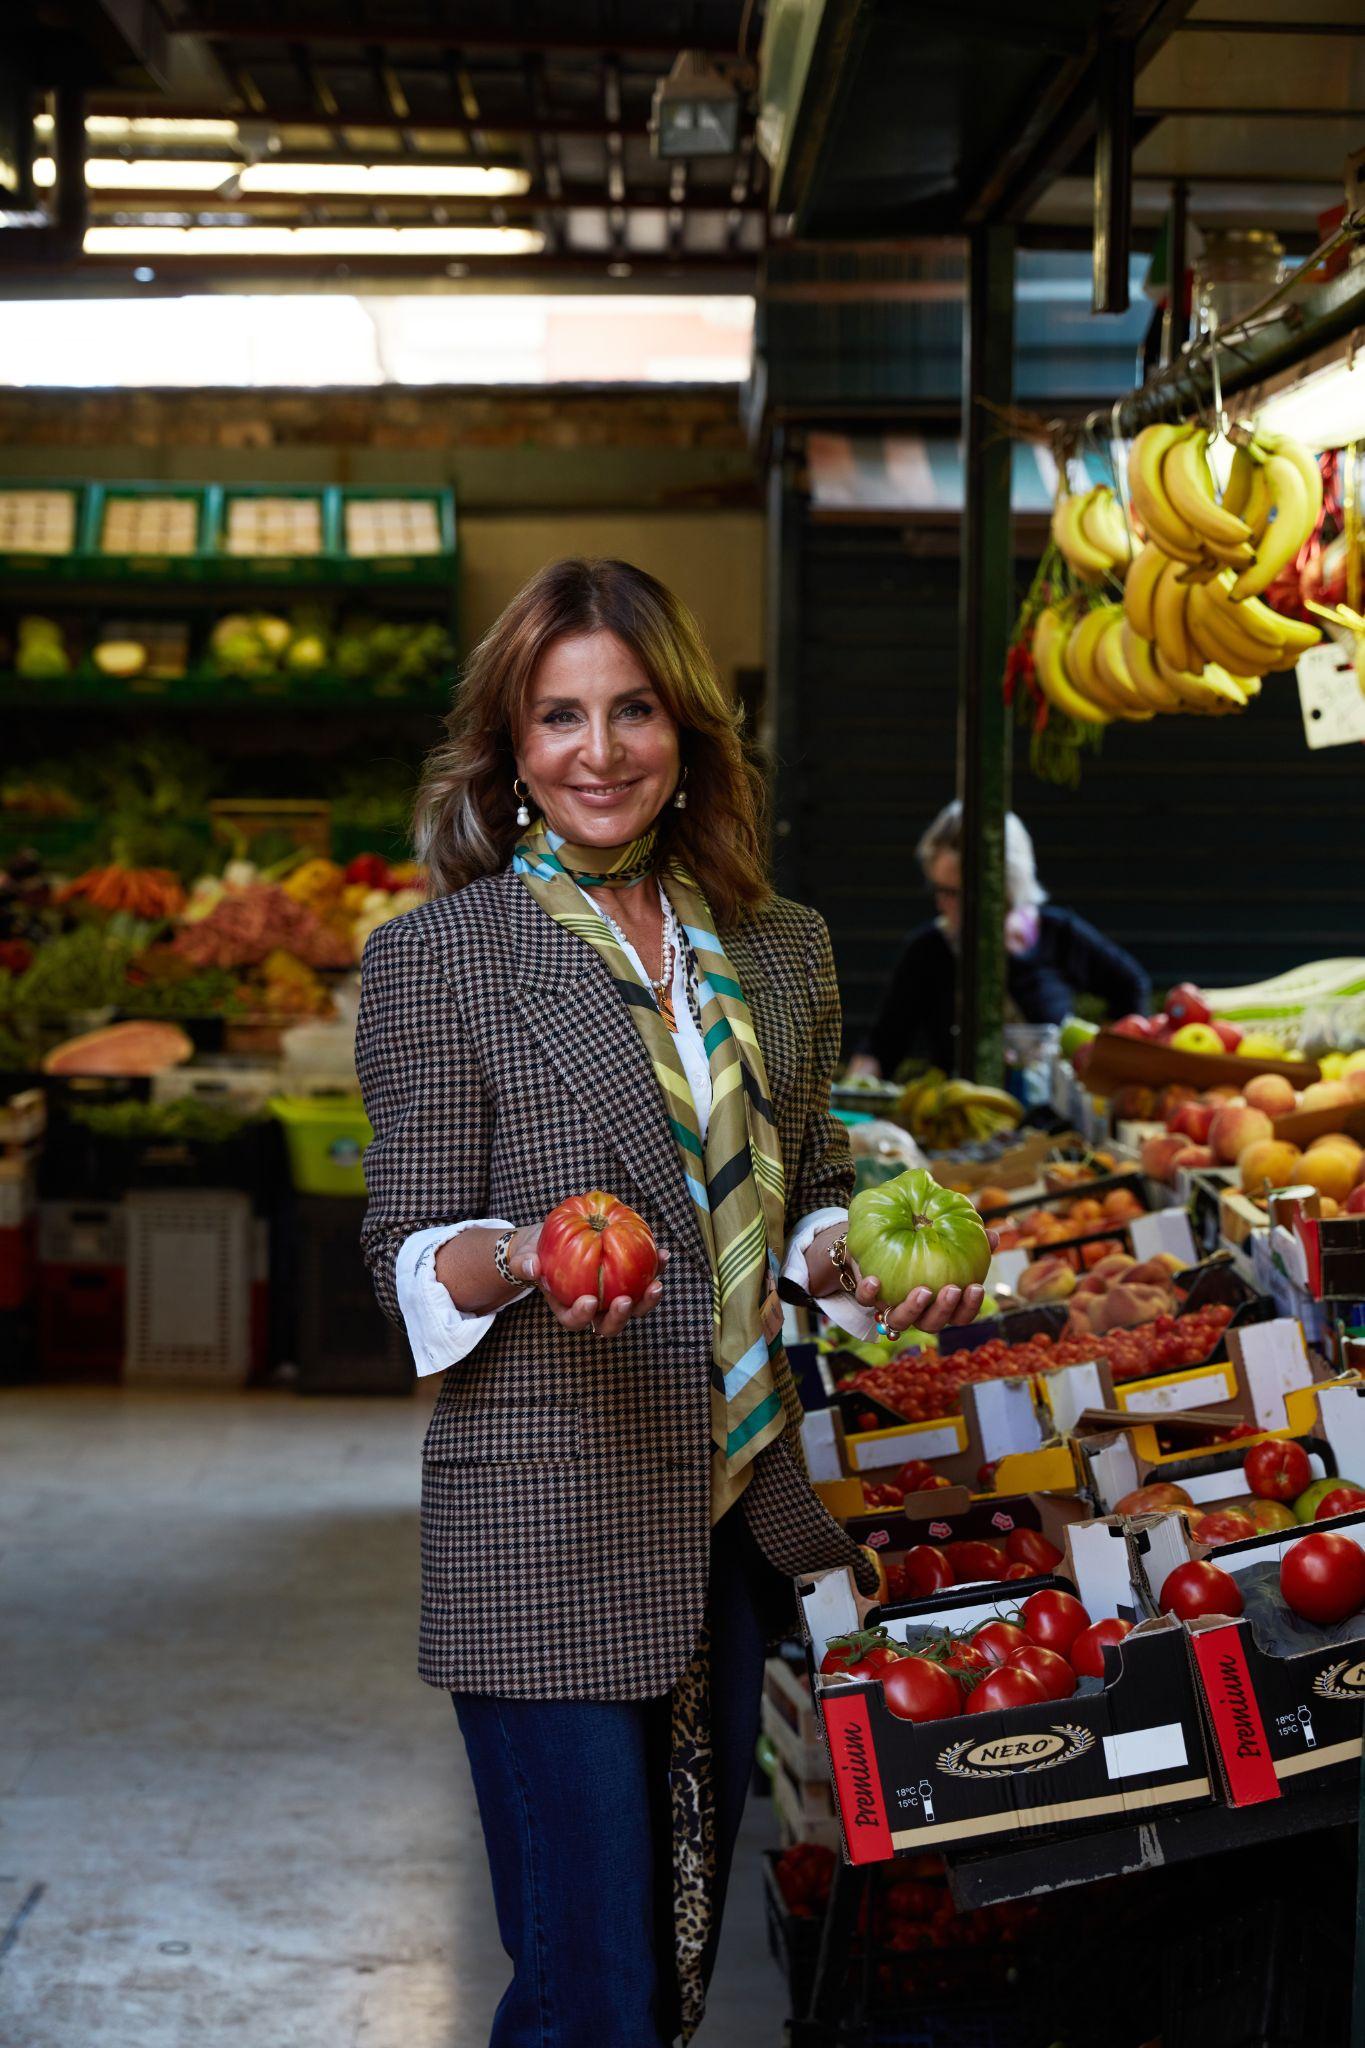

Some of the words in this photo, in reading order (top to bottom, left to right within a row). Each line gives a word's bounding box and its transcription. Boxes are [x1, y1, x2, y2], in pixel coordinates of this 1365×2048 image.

[980, 1739, 1049, 1762] NERO
[1219, 1654, 1262, 1759] Premium
[841, 1721, 880, 1827] Premium
